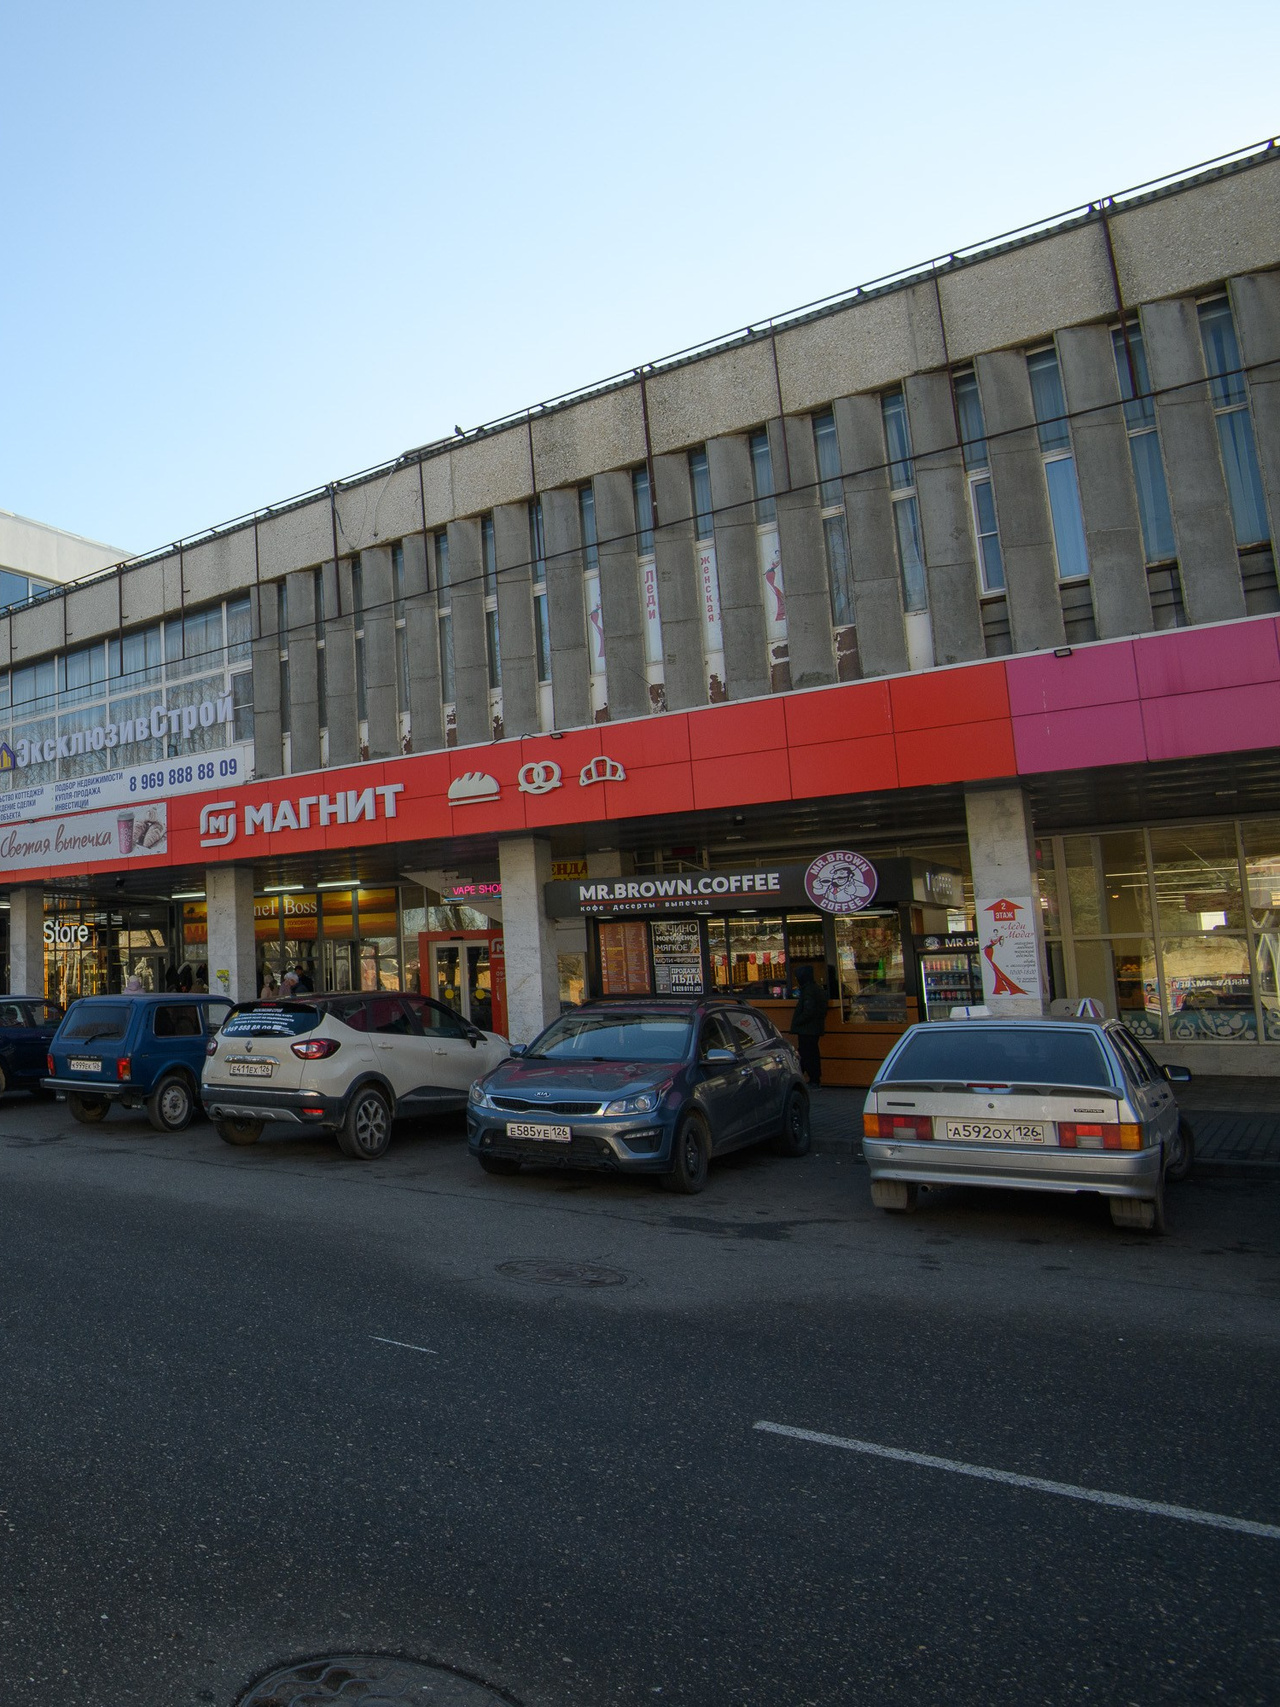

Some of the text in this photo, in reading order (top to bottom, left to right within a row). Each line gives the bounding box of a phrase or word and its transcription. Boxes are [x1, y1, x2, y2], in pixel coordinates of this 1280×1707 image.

[645, 570, 656, 620] Леди
[16, 690, 234, 767] ЭксклюзивСтрой
[55, 772, 123, 792] ПОДБОР НЕДВИЖИМОСТИ
[129, 758, 237, 792] 8 969 888 88 09
[14, 787, 44, 801] КОТТЕДЖЕЙ
[55, 786, 101, 802] КУПЛЯ-ПРОДАЖА
[16, 799, 37, 809] СДЕЛКИ
[54, 799, 89, 811] ИНВЕСТИЦИИ
[244, 783, 404, 836] МАГНИТ
[0, 811, 21, 822] ОБЪЕКТА
[0, 823, 112, 859] Свежая выпечка
[810, 853, 870, 876] MR.BROWN
[453, 885, 476, 895] VAPE
[579, 873, 780, 901] MR.BROWN.COFFEE
[284, 899, 317, 915] Boss
[580, 899, 709, 912] кофе десерты выпечка
[820, 897, 863, 911] COFFEE
[1000, 902, 1006, 910] 2
[995, 911, 1013, 919] ЭТАЖ
[43, 920, 89, 943] Store
[656, 943, 688, 952] МЯГКОЕ
[672, 974, 701, 985] ЛЬДА
[232, 1065, 270, 1074] Е411ЕХ 126
[510, 1125, 550, 1138] Е585УЕ
[551, 1126, 568, 1136] 126
[952, 1124, 1038, 1140] А592ОХ 126
